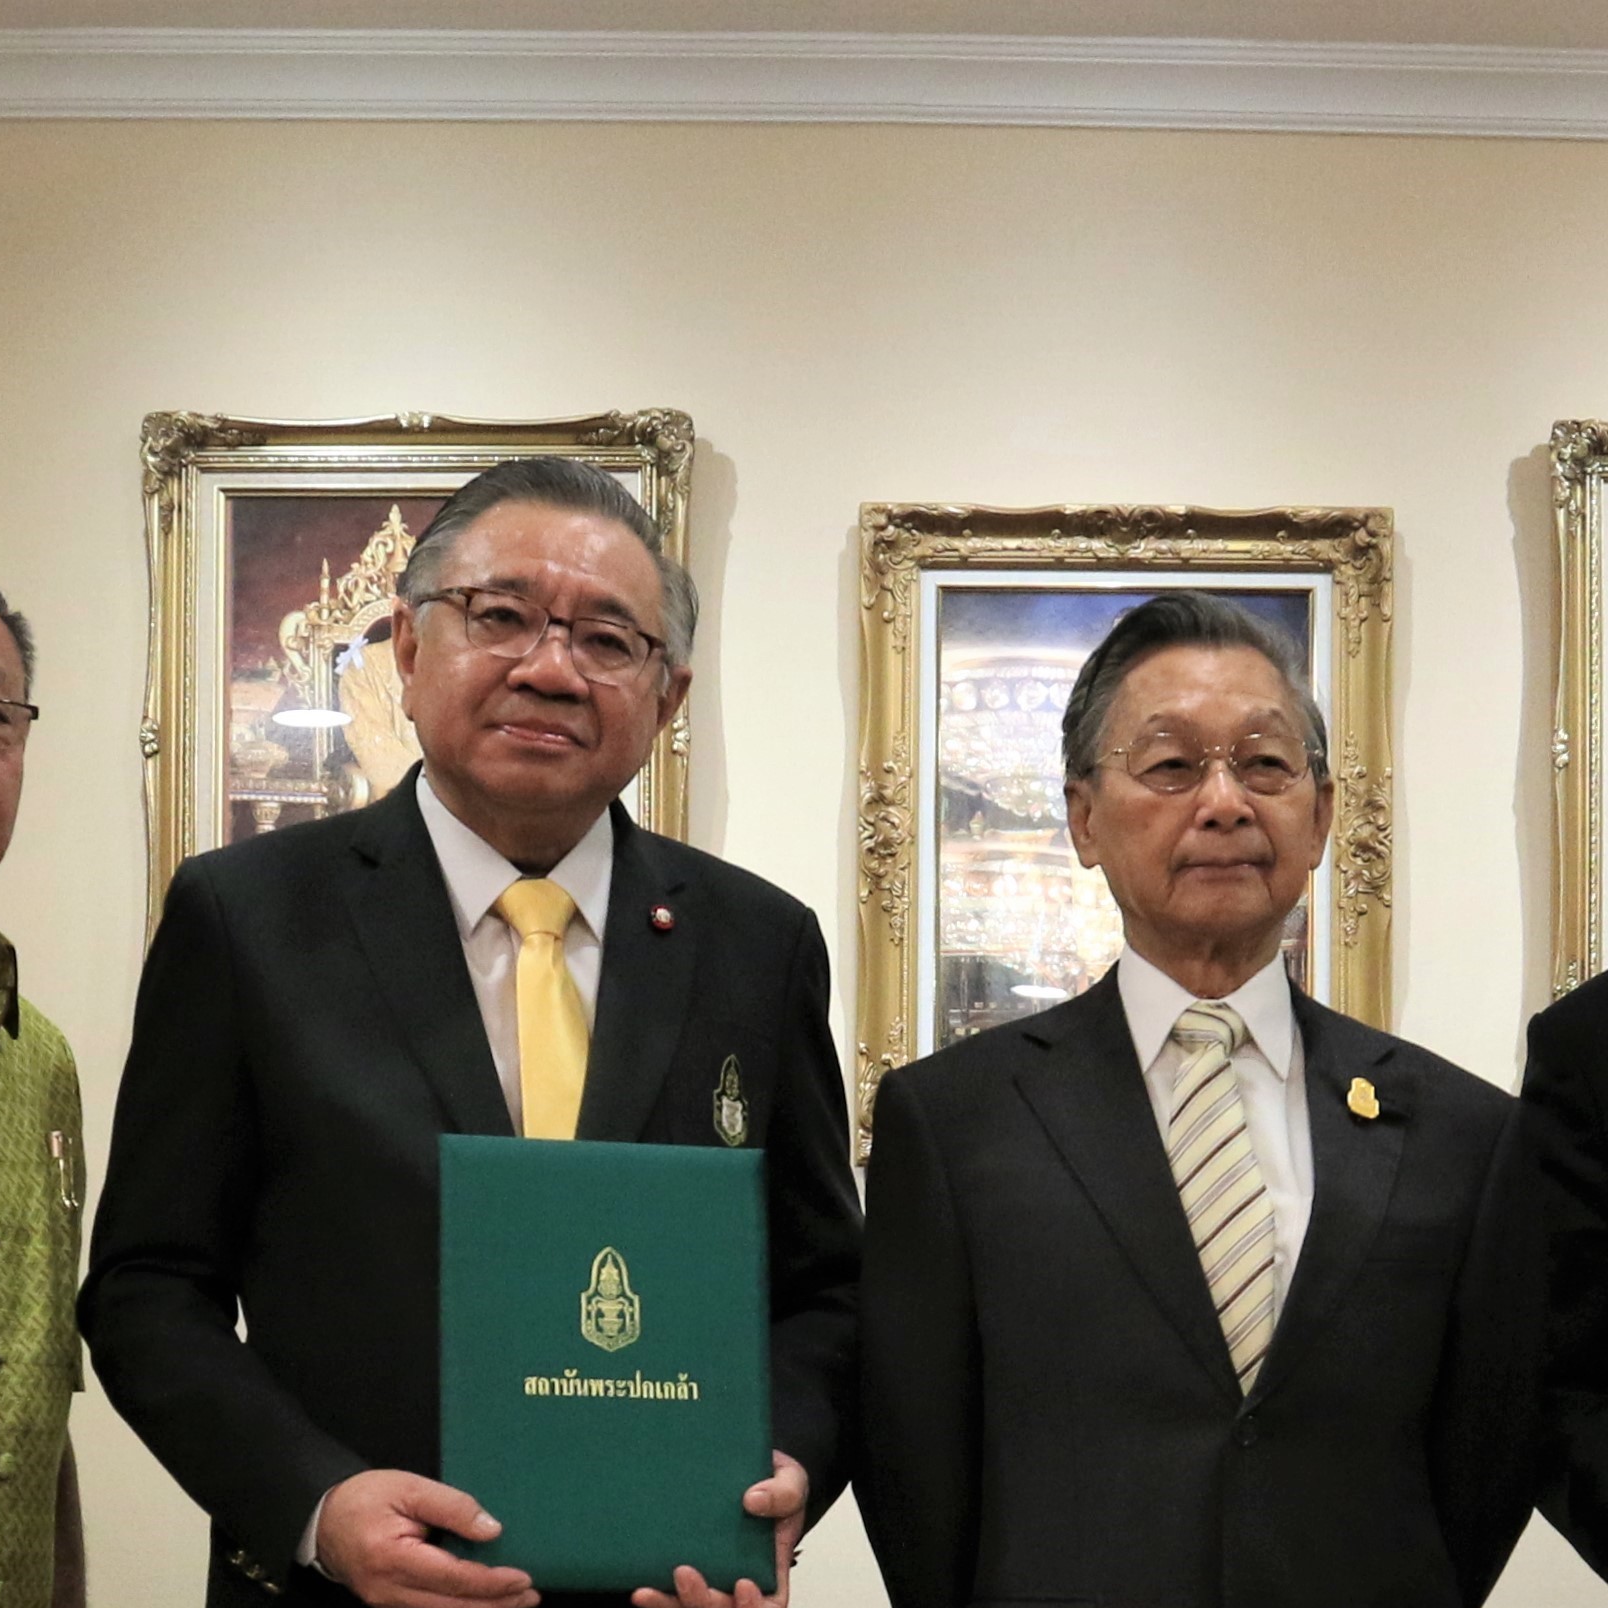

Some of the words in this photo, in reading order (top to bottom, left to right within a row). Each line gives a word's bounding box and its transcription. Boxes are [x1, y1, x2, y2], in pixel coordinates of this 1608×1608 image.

[524, 1368, 699, 1400] สถาบันพระปกเกล้า
